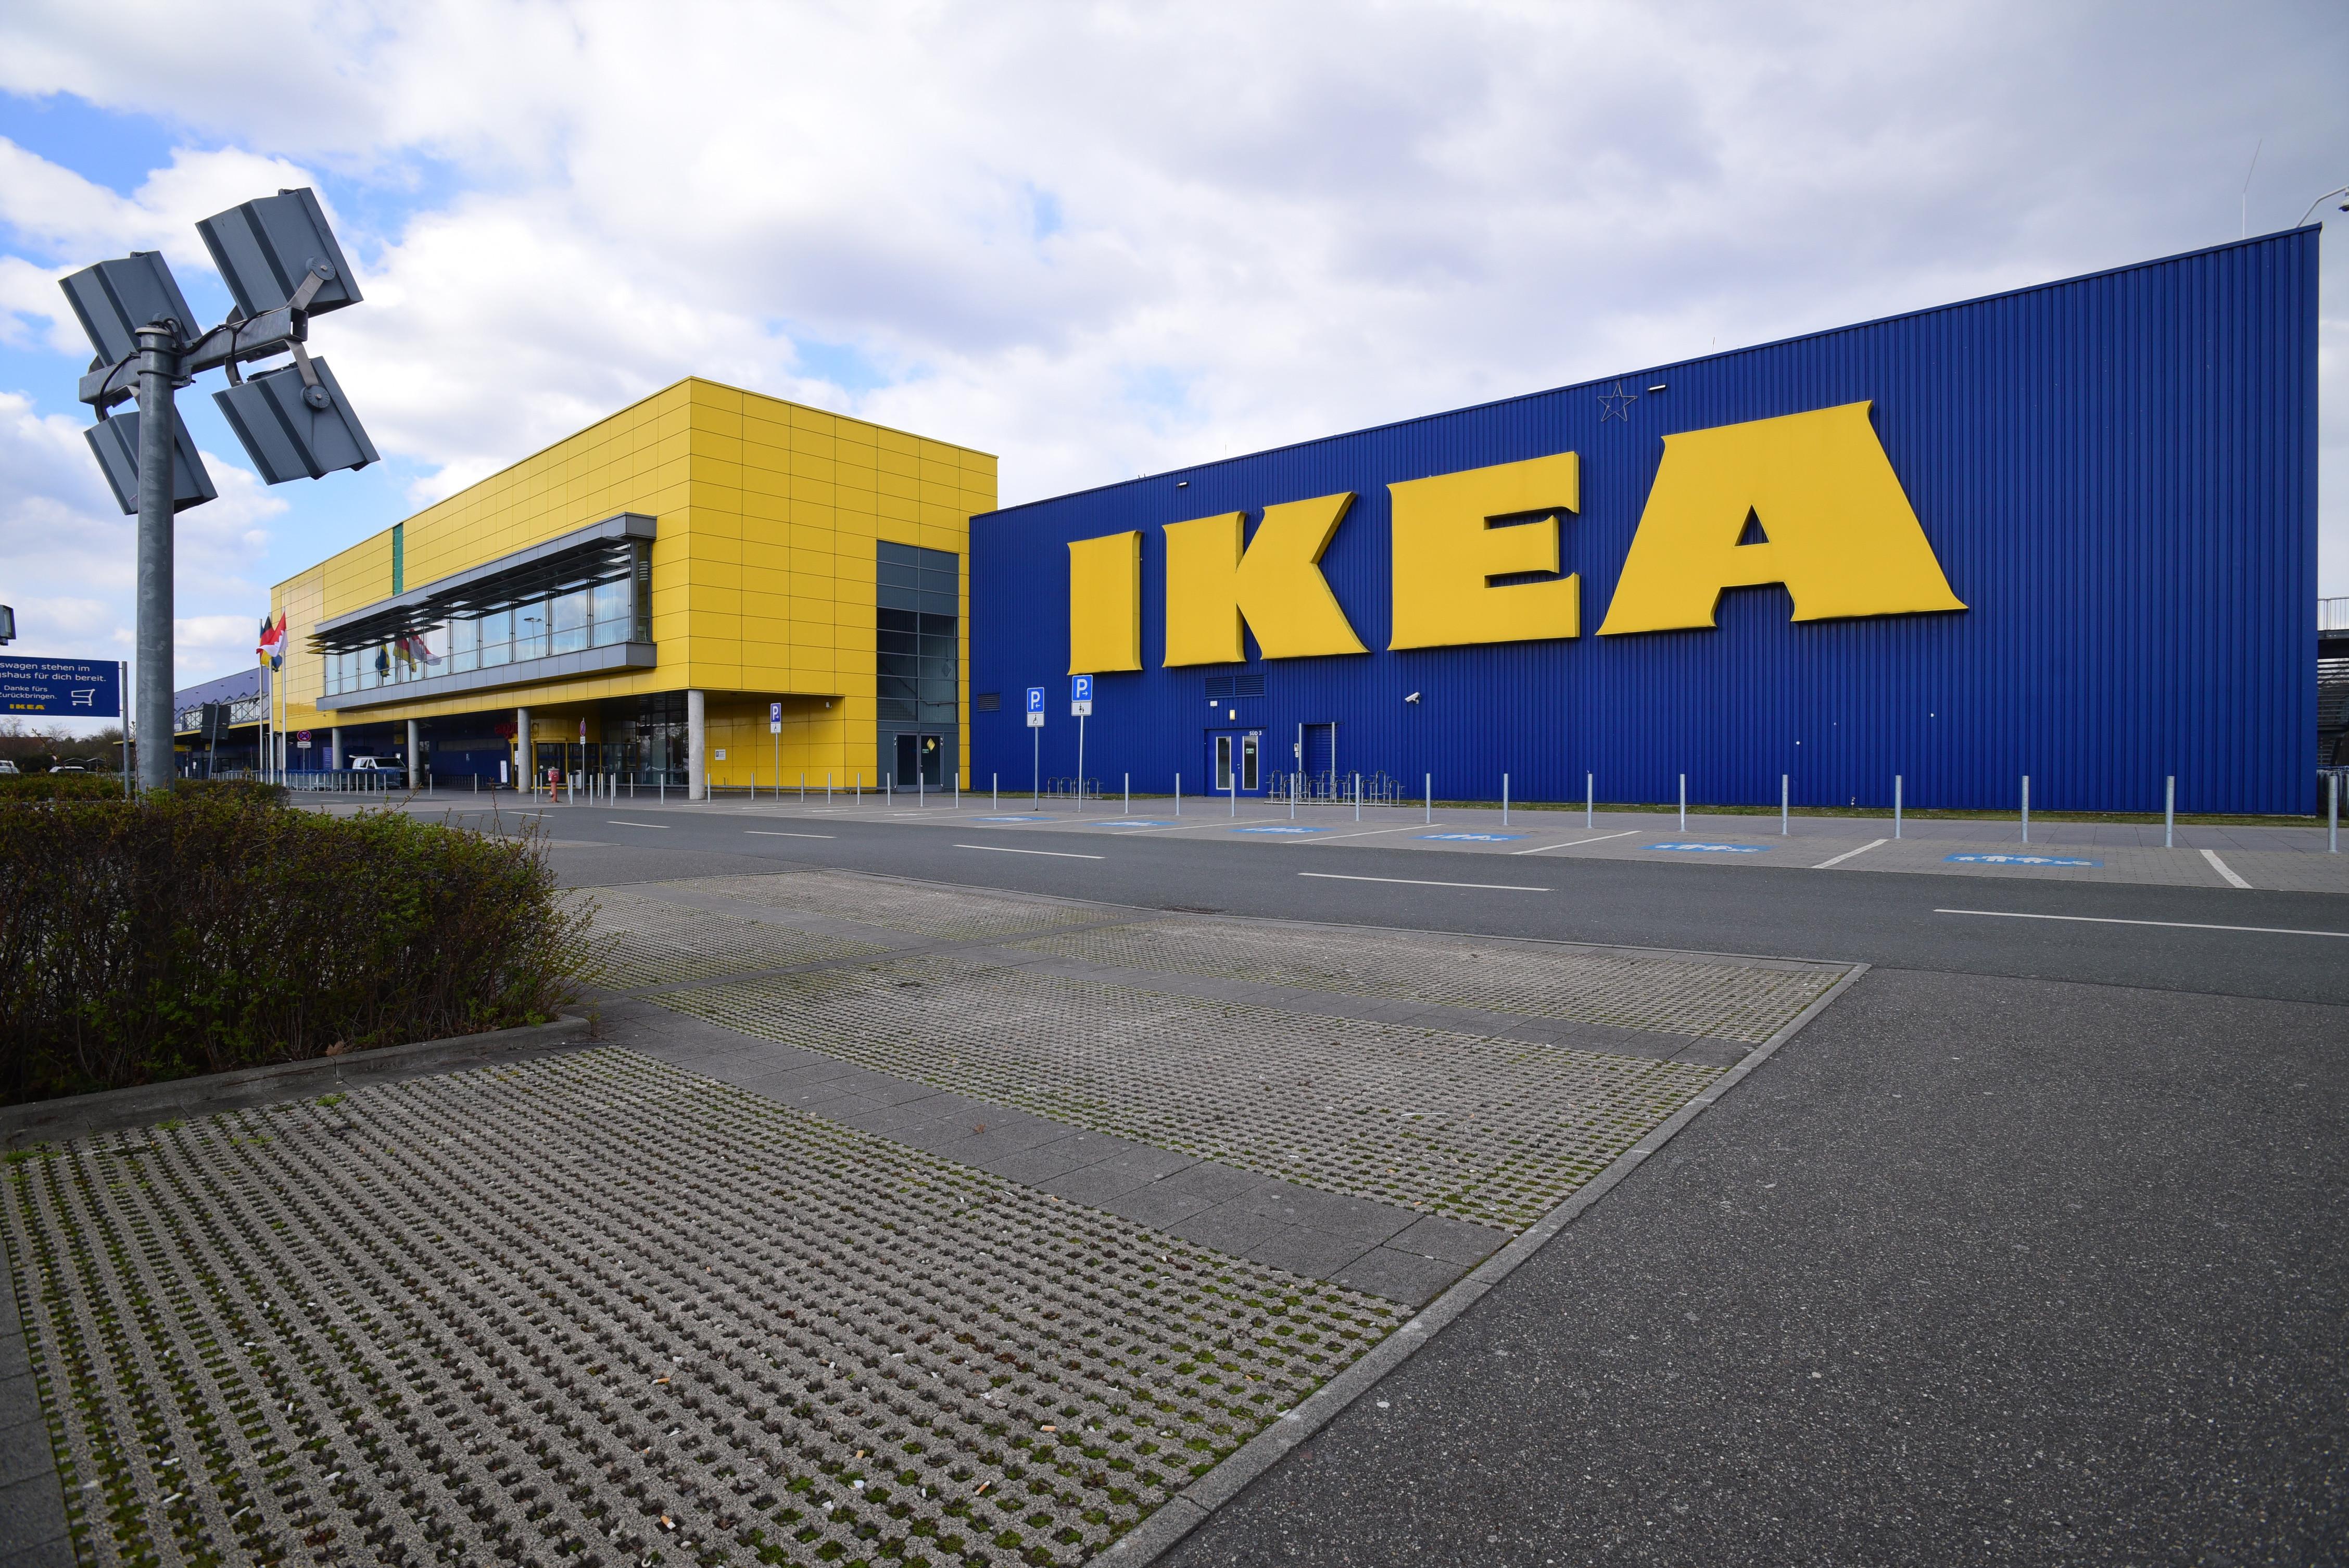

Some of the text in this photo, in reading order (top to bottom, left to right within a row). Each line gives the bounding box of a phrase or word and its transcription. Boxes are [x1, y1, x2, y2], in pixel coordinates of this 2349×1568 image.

[1067, 400, 1968, 676] IKEA
[1076, 679, 1088, 698] P
[1031, 691, 1040, 710] P
[773, 706, 778, 720] P
